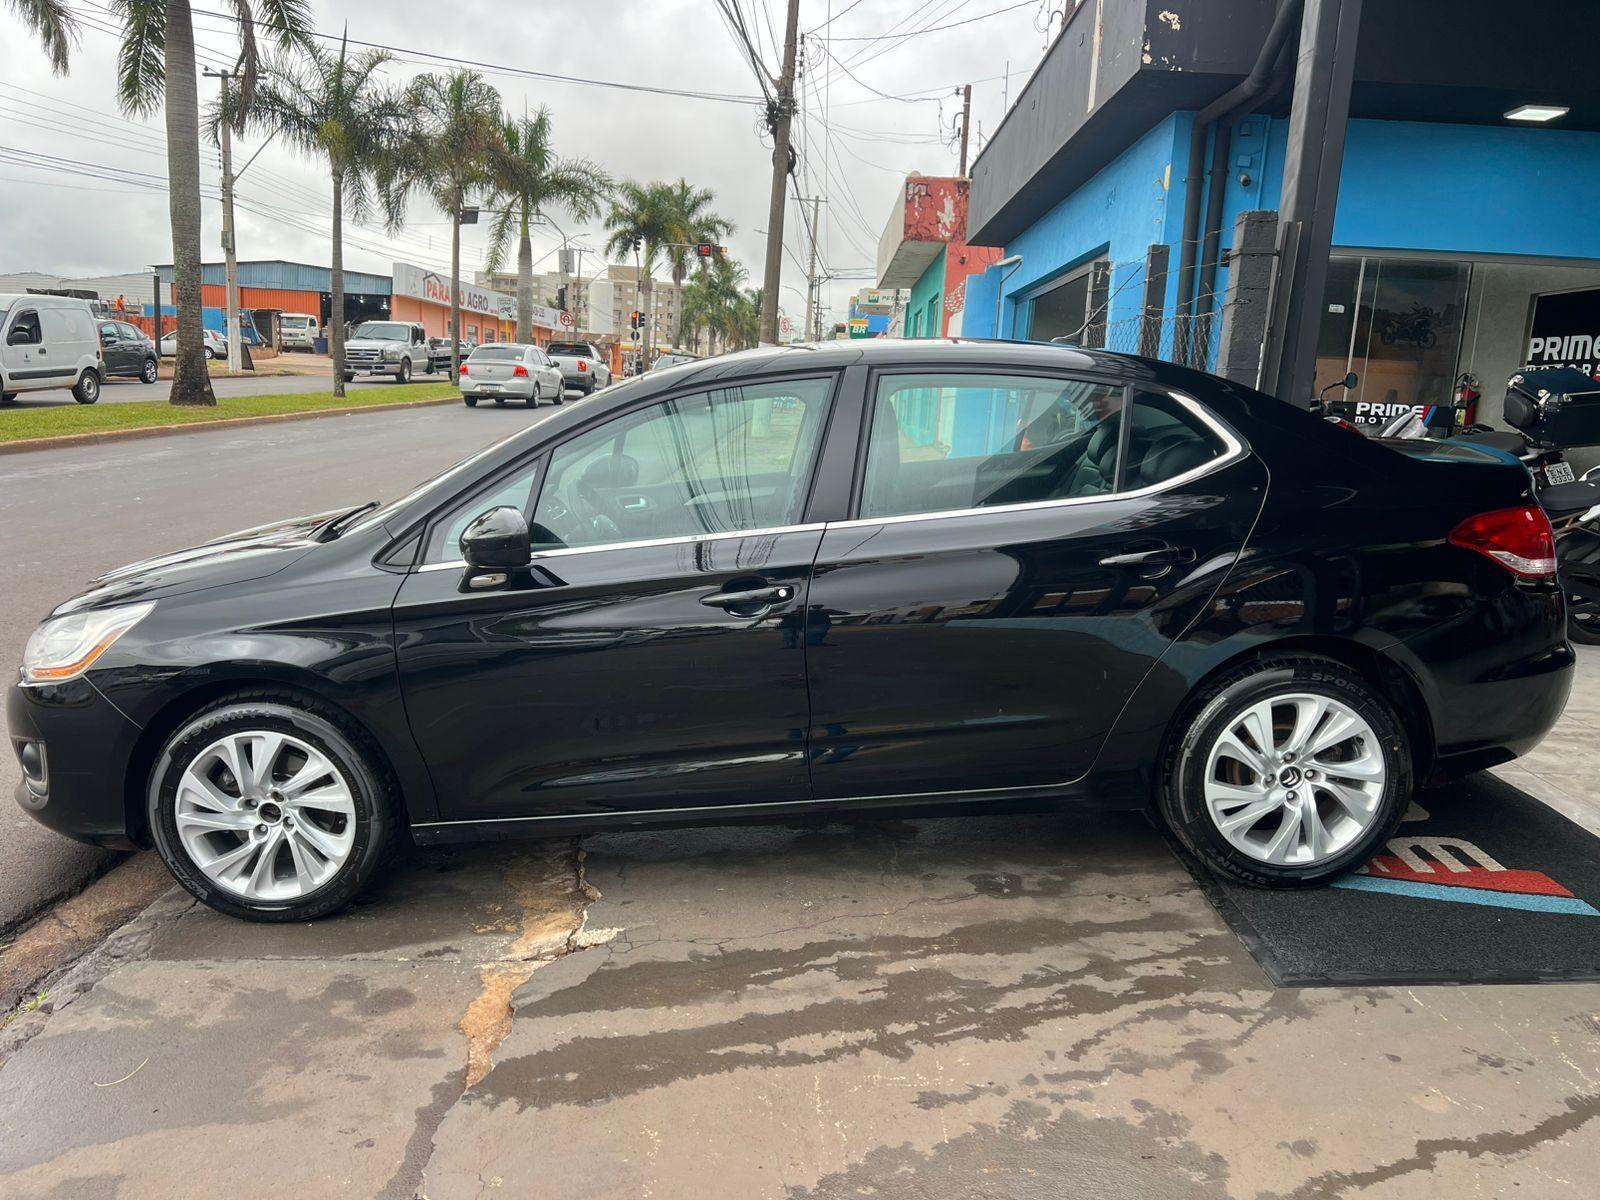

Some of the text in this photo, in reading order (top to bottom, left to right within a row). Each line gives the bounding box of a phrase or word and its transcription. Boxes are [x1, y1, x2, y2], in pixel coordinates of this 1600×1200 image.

[467, 292, 489, 311] AGRO
[851, 325, 866, 334] BR
[1310, 672, 1368, 698] SPORT
